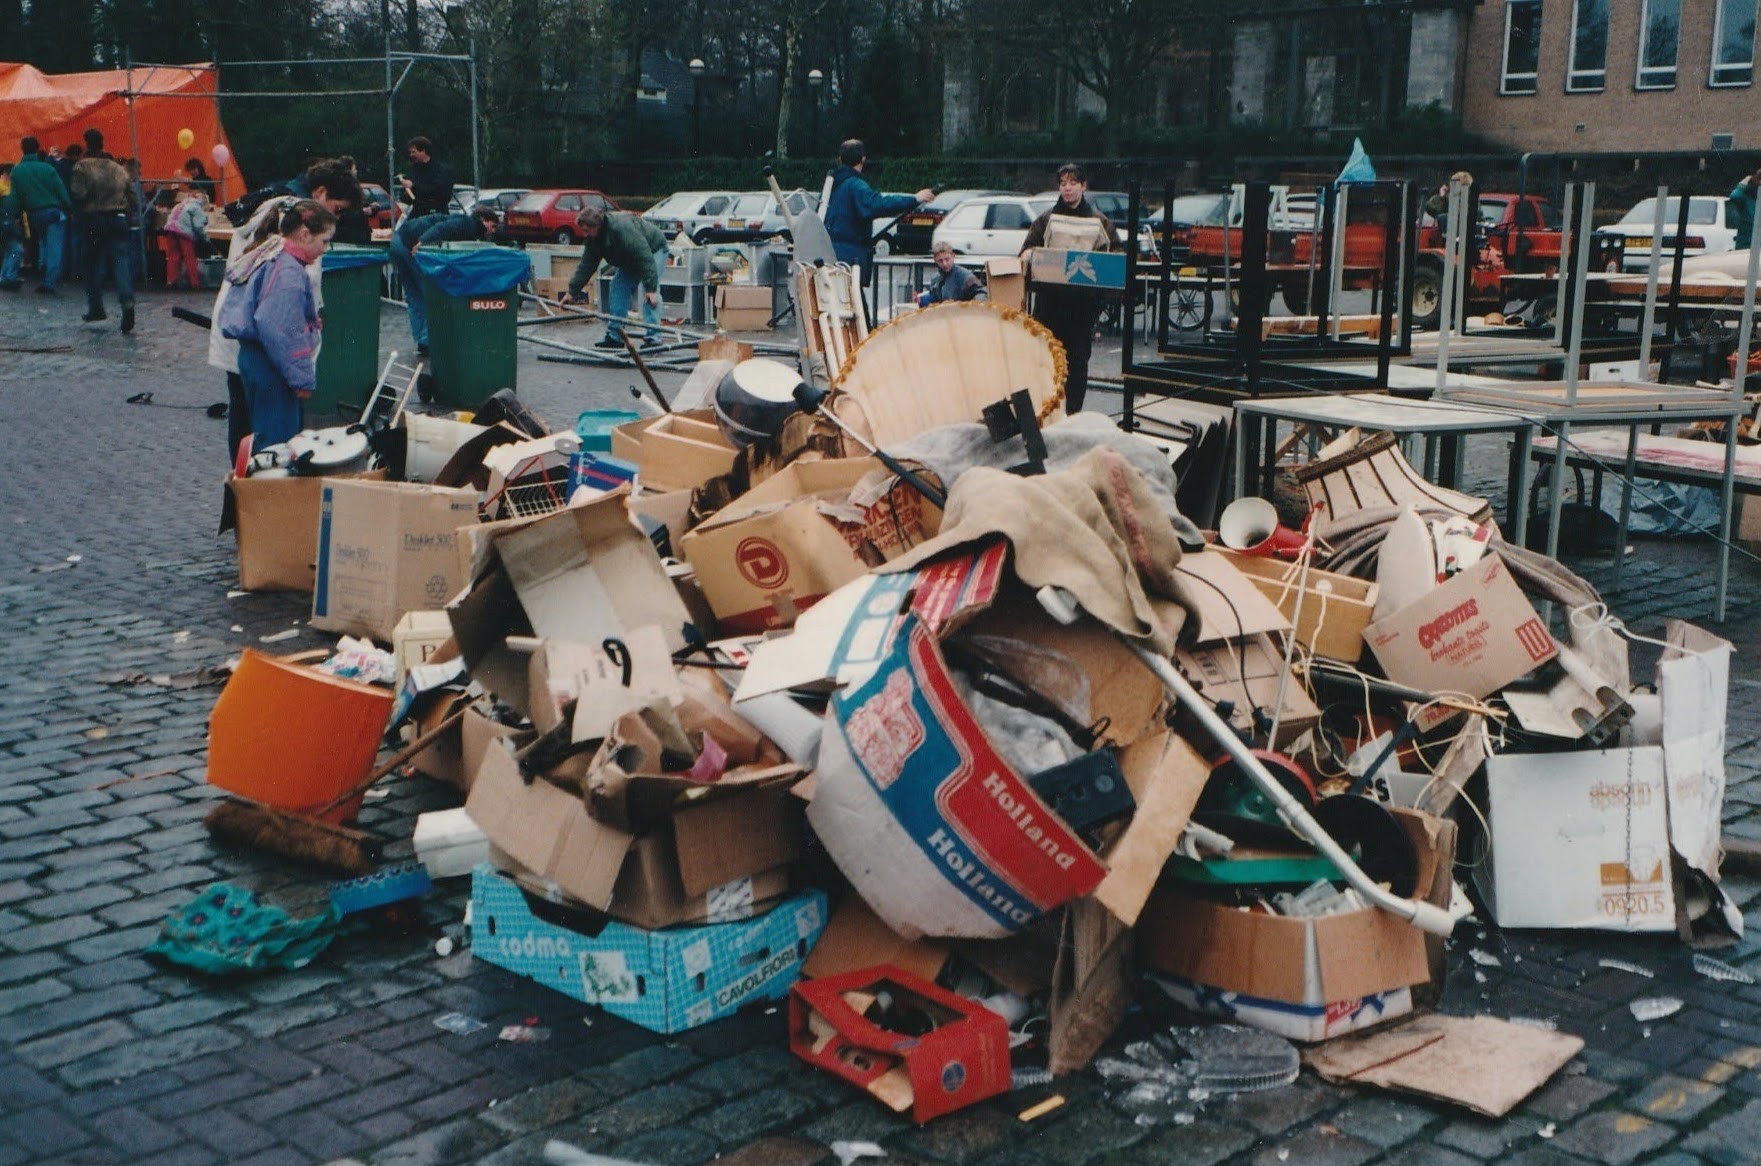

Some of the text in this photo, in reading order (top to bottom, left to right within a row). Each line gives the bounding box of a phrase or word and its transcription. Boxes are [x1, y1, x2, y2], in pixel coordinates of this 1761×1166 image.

[472, 301, 505, 310] SULO
[982, 771, 1076, 870] Holland
[927, 828, 1032, 924] Holland
[1603, 895, 1665, 917] 0920.5
[718, 948, 796, 1007] CAVOLFIORI
